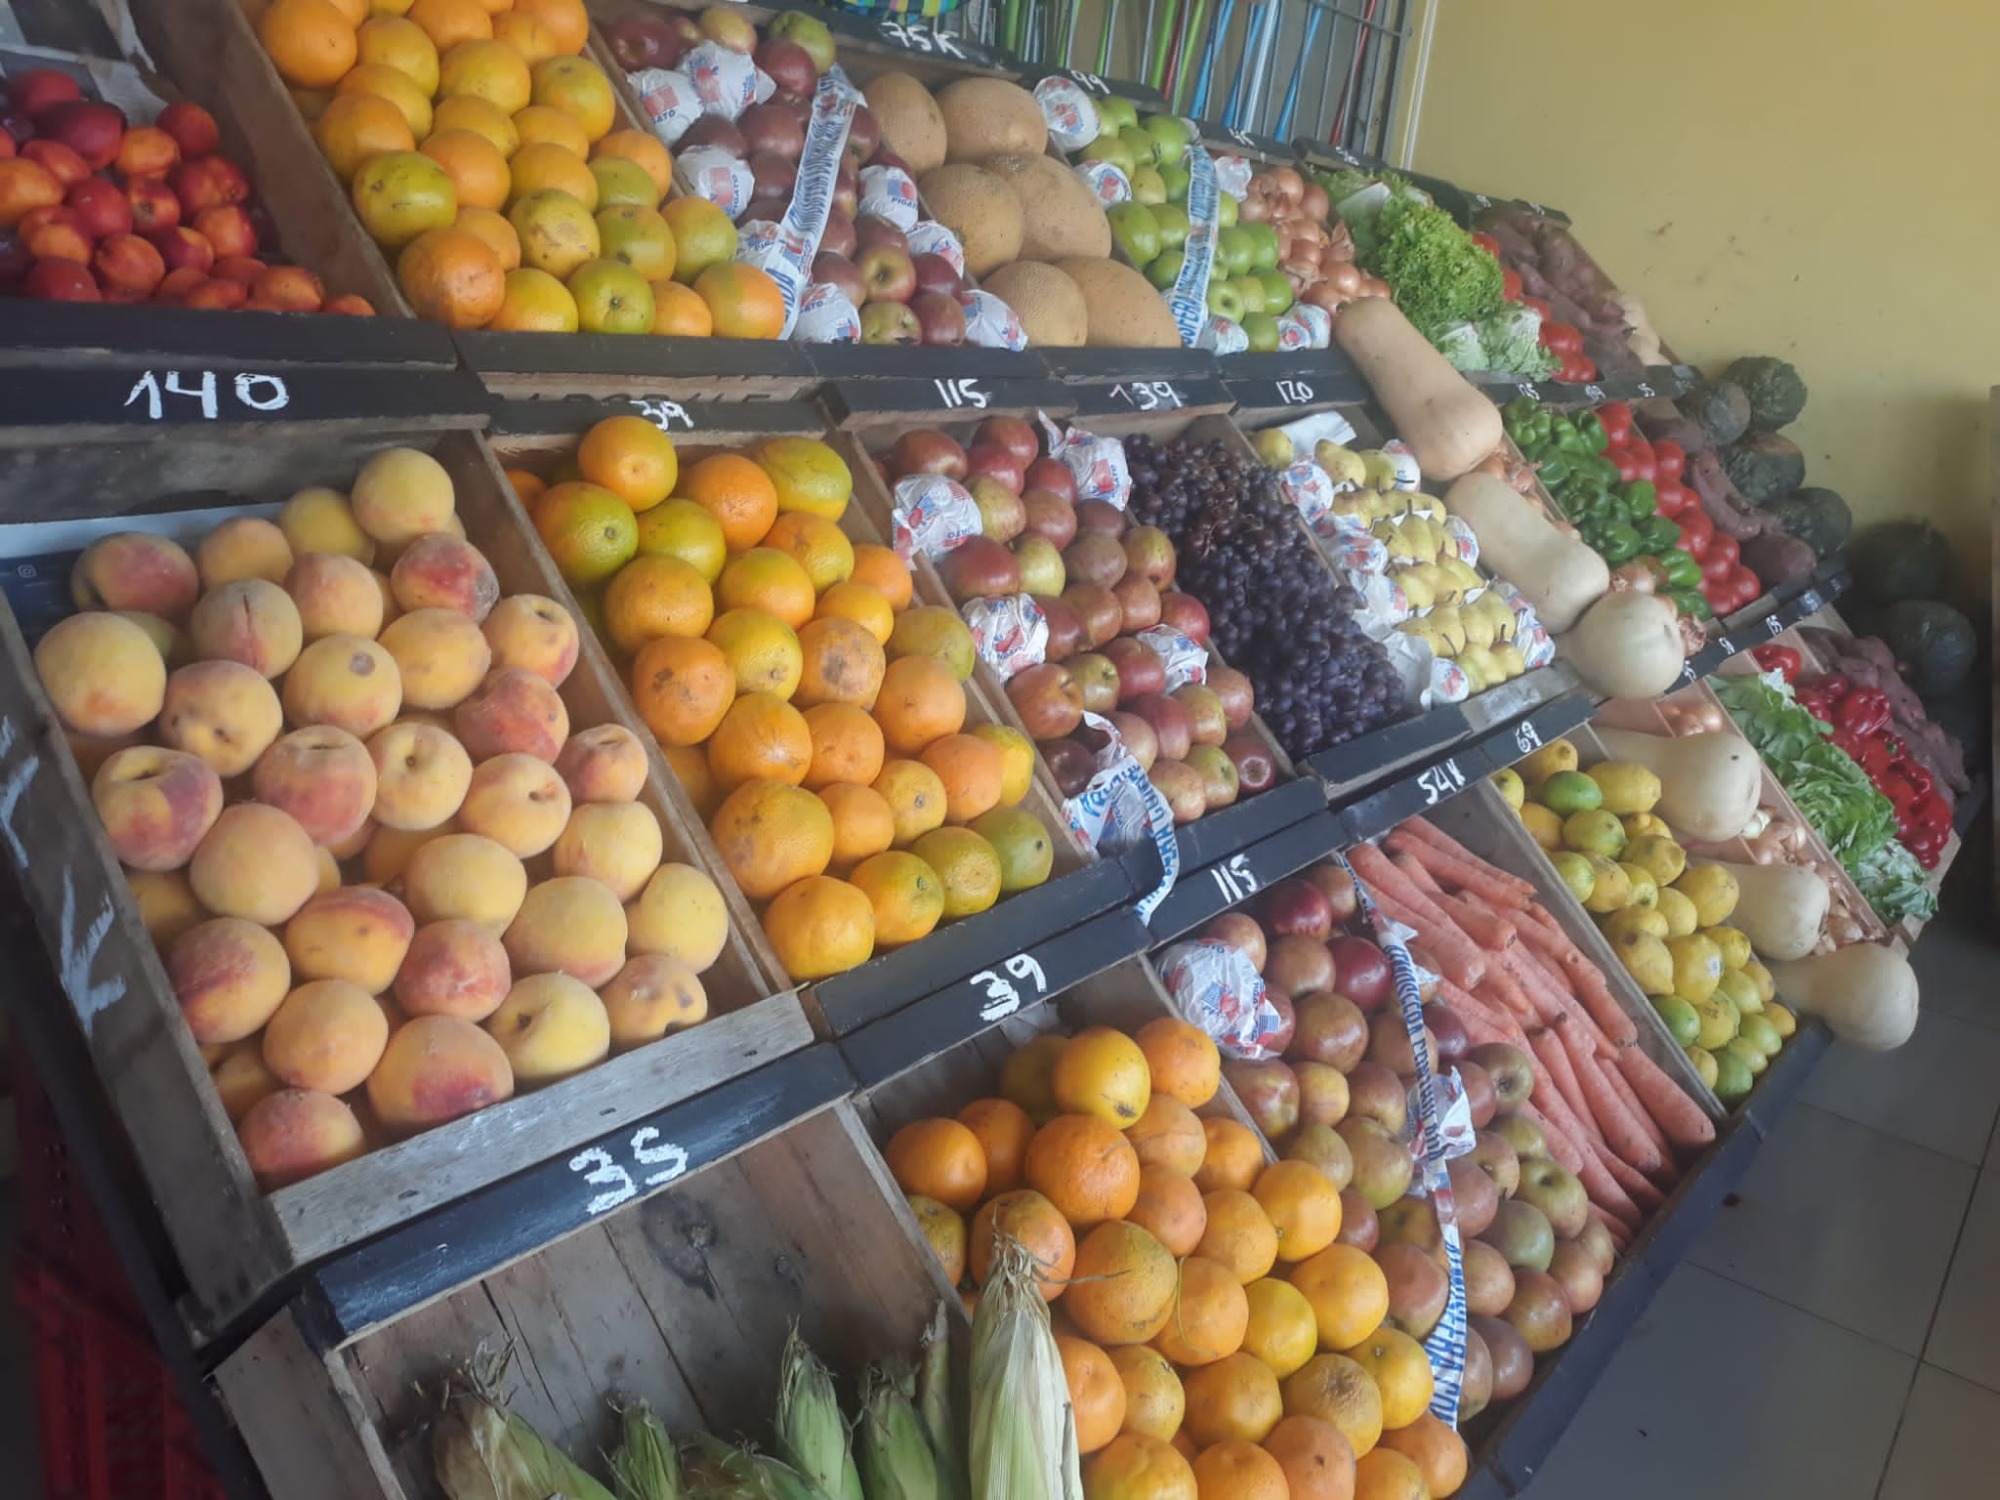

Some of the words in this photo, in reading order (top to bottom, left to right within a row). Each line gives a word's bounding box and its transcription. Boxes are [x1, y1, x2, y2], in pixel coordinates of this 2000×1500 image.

[1070, 69, 1111, 94] 99
[124, 370, 290, 420] 140
[934, 378, 988, 409] 115
[1275, 380, 1313, 404] 120
[629, 399, 695, 431] 39
[1515, 721, 1543, 753] 69
[1210, 853, 1258, 904] 115
[969, 953, 1048, 1021] 39
[569, 1126, 689, 1215] 35
